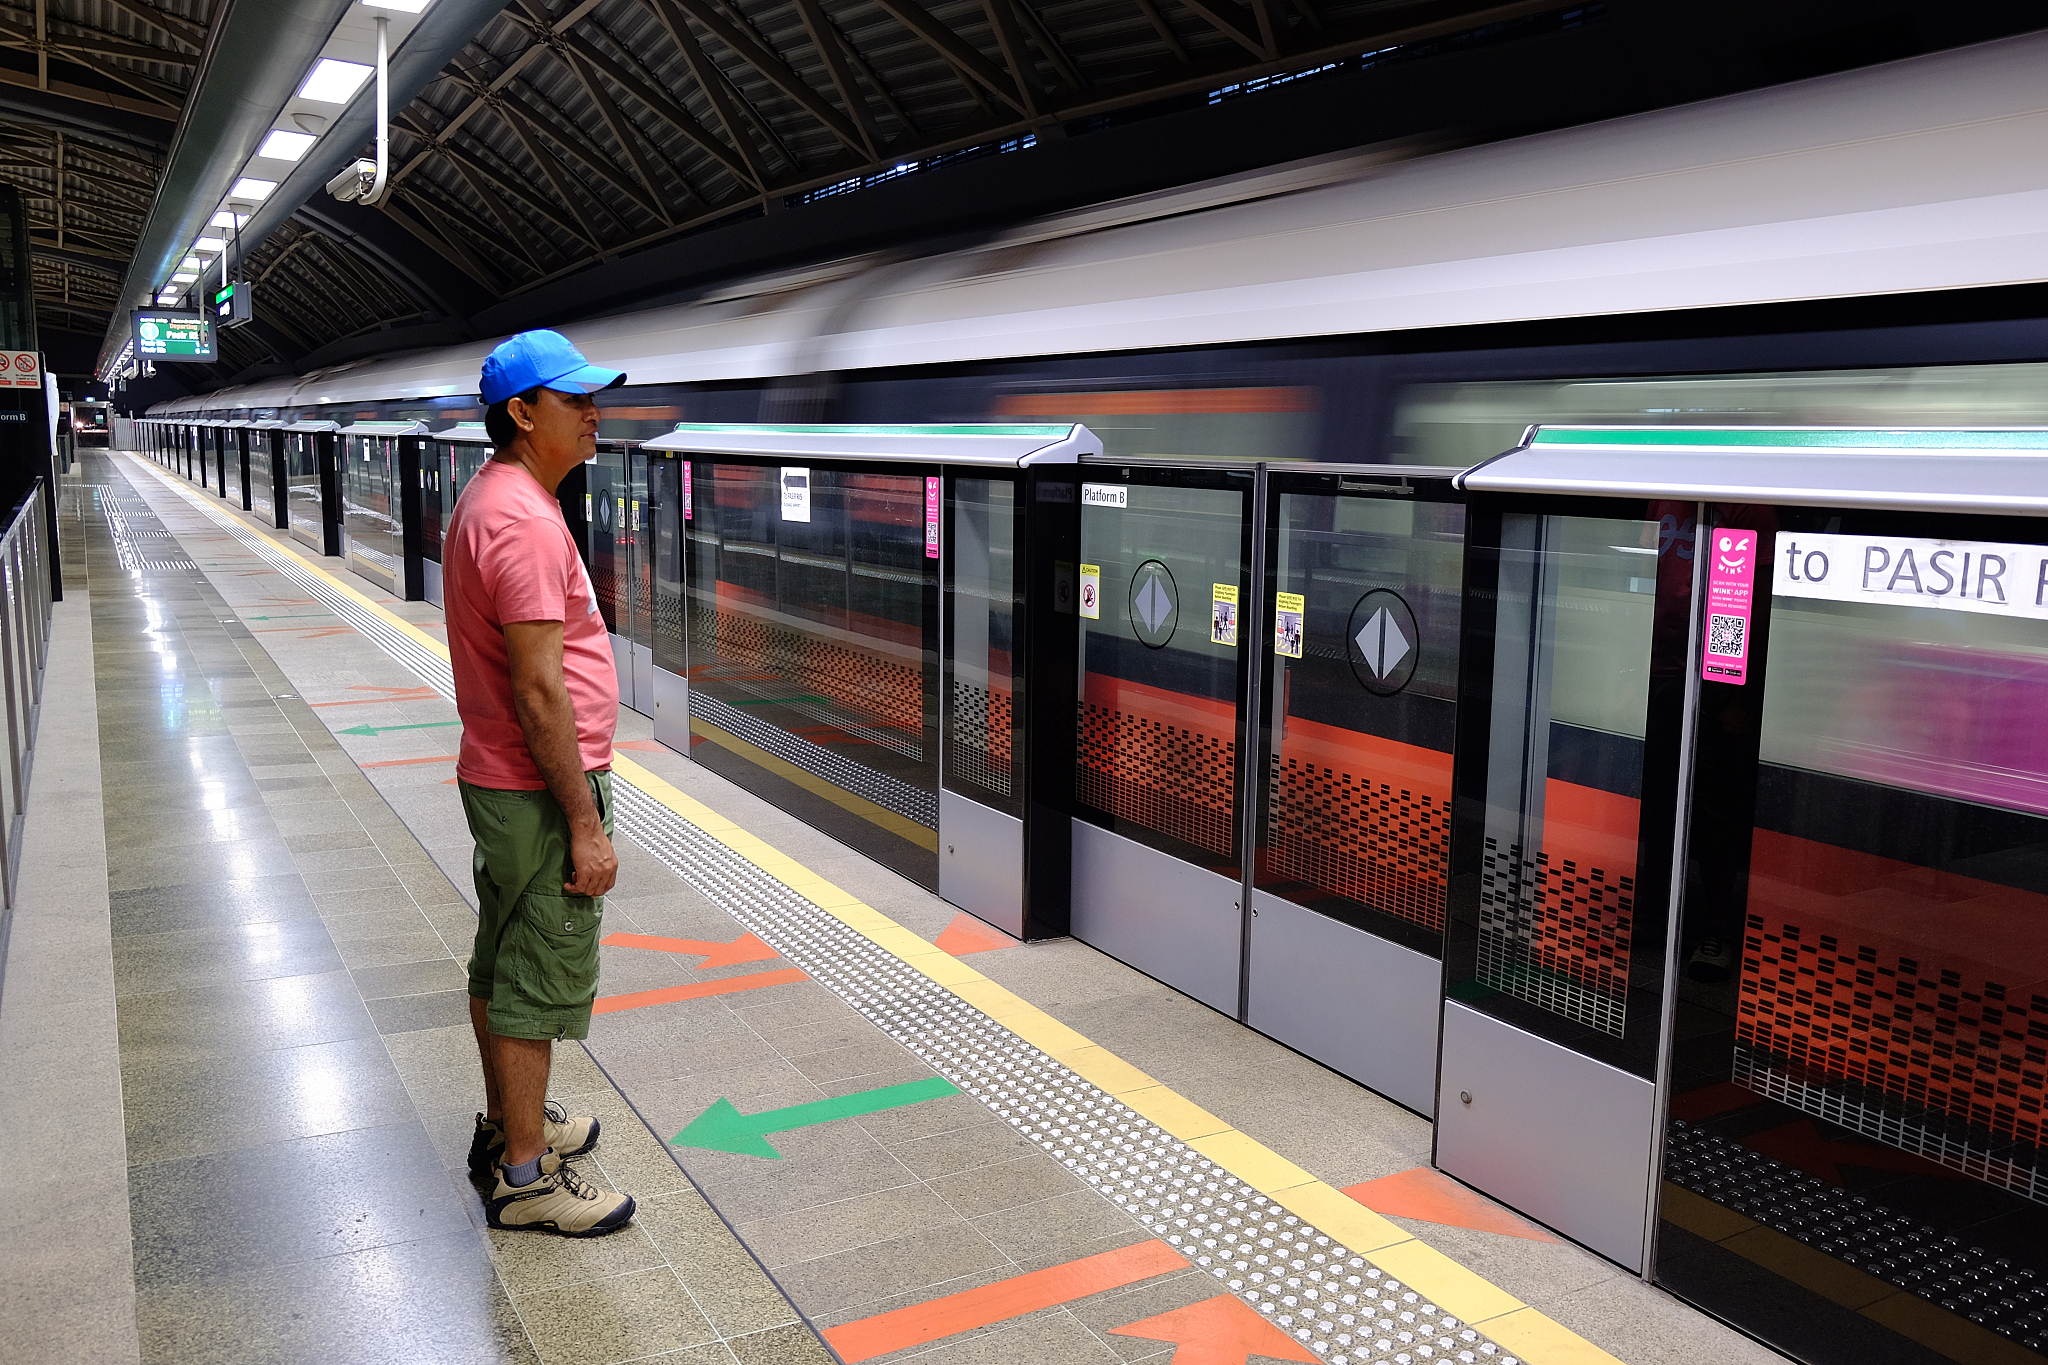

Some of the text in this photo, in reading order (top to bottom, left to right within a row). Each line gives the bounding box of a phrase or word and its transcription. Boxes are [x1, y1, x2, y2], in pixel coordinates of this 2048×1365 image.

[0, 413, 26, 421] orm B
[1084, 488, 1124, 504] Platform B
[1786, 541, 1830, 582] to
[1862, 545, 2006, 602] PASIR
